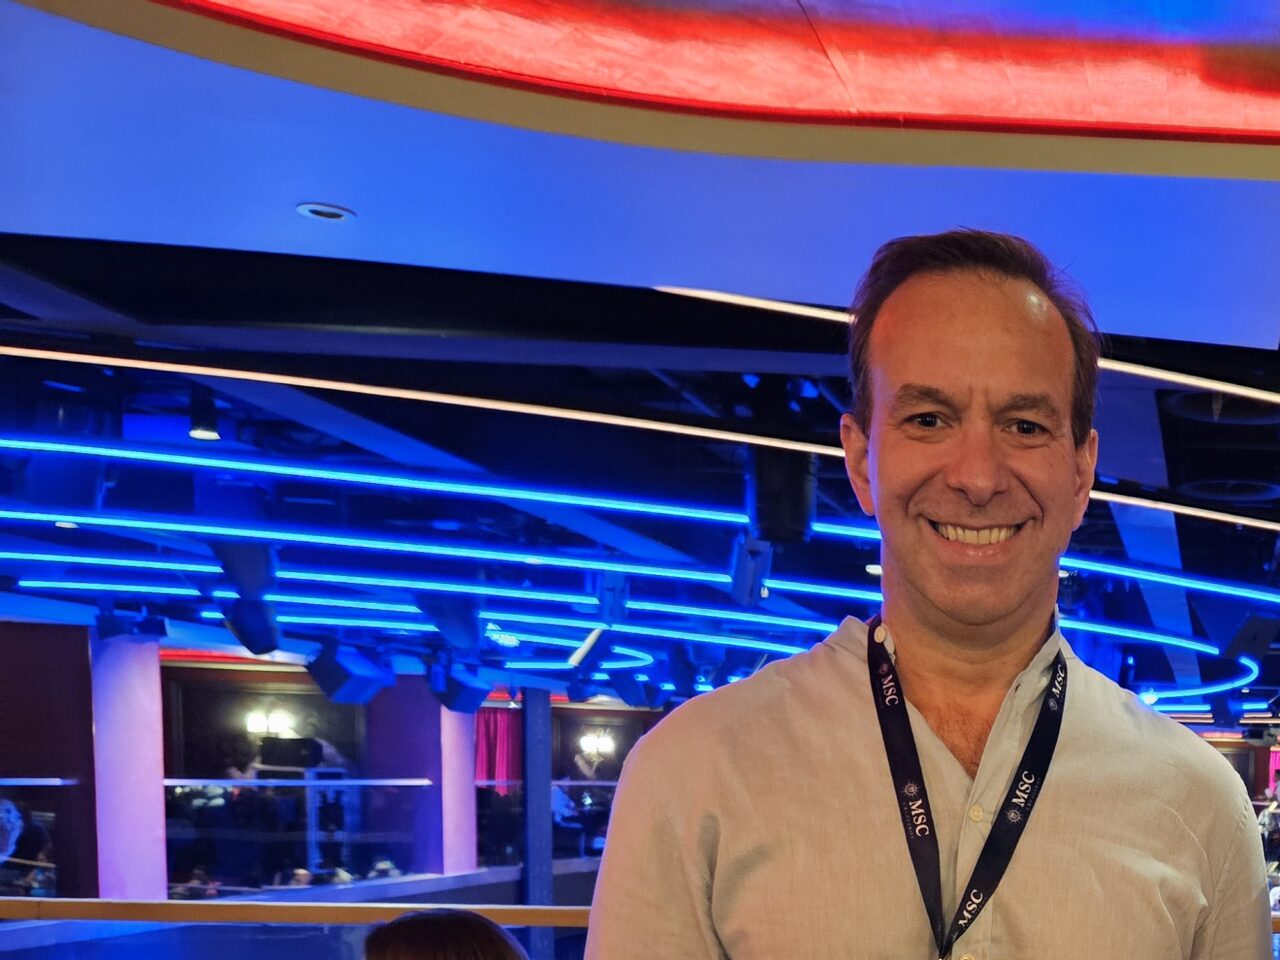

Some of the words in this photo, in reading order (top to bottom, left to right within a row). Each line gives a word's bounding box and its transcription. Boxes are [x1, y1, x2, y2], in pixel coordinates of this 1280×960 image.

[881, 673, 899, 707] MSC
[1052, 663, 1066, 699] MSC
[1011, 770, 1035, 808] MSC
[909, 798, 930, 838] MSC
[957, 888, 984, 929] MSC
